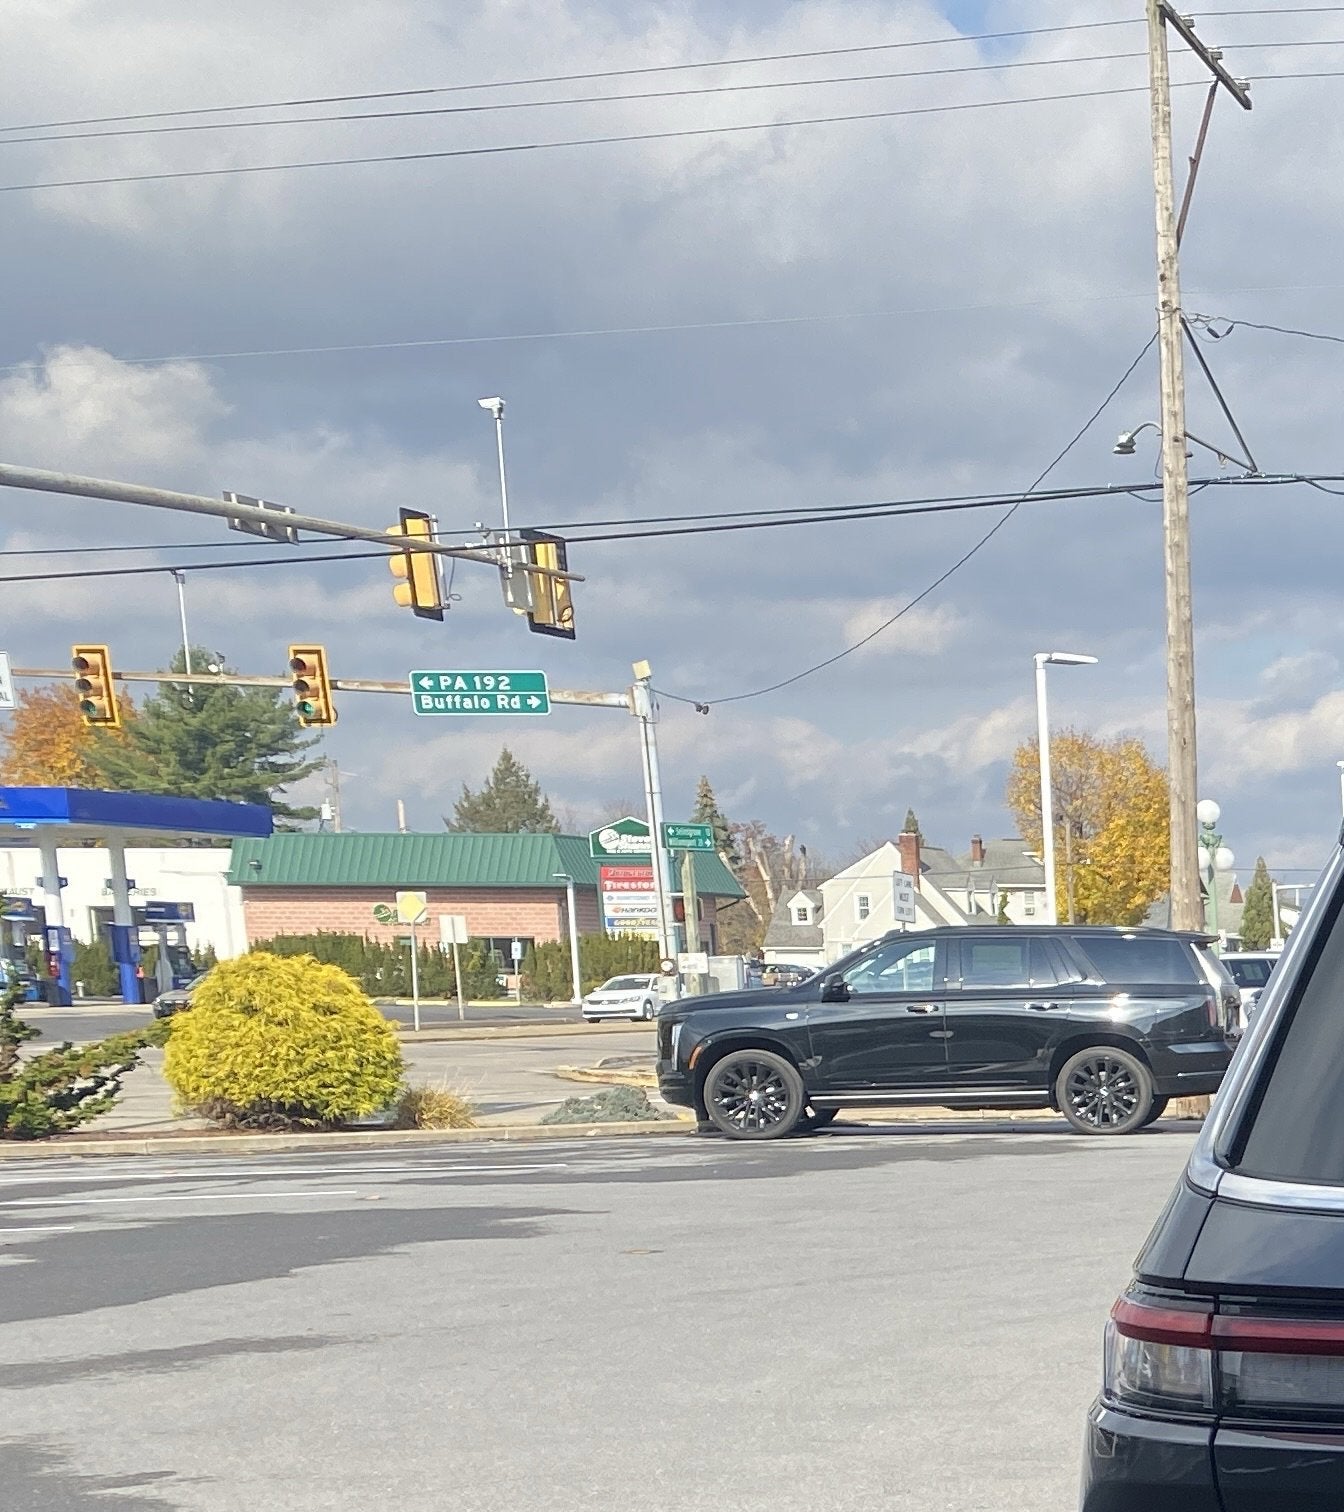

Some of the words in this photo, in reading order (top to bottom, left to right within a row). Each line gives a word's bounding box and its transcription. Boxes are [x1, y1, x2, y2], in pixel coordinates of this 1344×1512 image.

[439, 675, 468, 690] PA
[473, 675, 511, 690] 192
[420, 695, 491, 709] Buffalo
[496, 695, 521, 709] Rd
